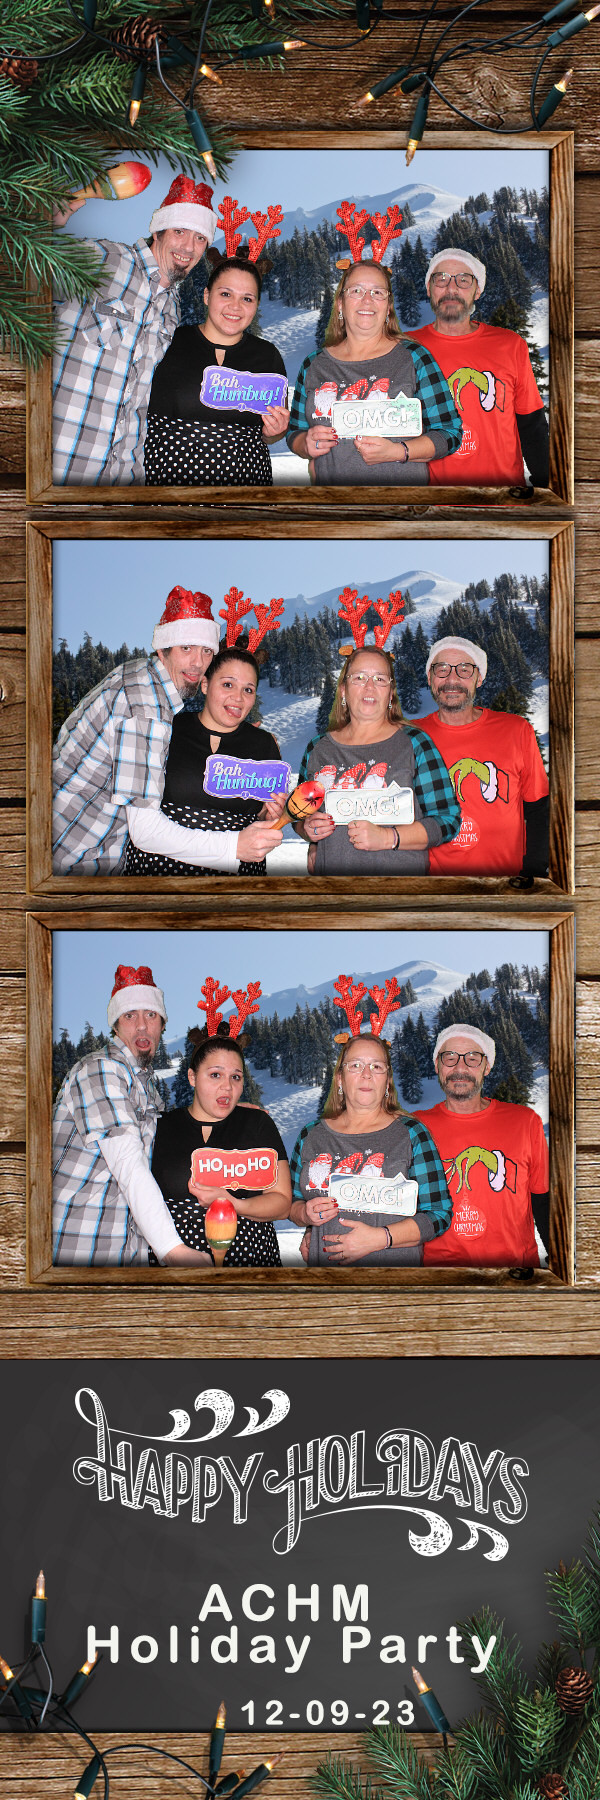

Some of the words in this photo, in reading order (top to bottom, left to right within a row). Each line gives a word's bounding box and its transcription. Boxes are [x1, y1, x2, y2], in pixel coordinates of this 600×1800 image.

[210, 373, 239, 389] Bah
[209, 384, 280, 405] Humbug!
[343, 407, 408, 429] OMG!
[212, 761, 243, 777] Bah
[211, 772, 283, 793] Humbug!
[336, 795, 401, 818] OMG!
[198, 1157, 222, 1173] HO
[223, 1163, 247, 1178] HO
[247, 1156, 271, 1172] HO
[339, 1182, 403, 1207] OMG!
[455, 1210, 479, 1222] MERRY
[453, 1222, 485, 1233] CHRISTMAS
